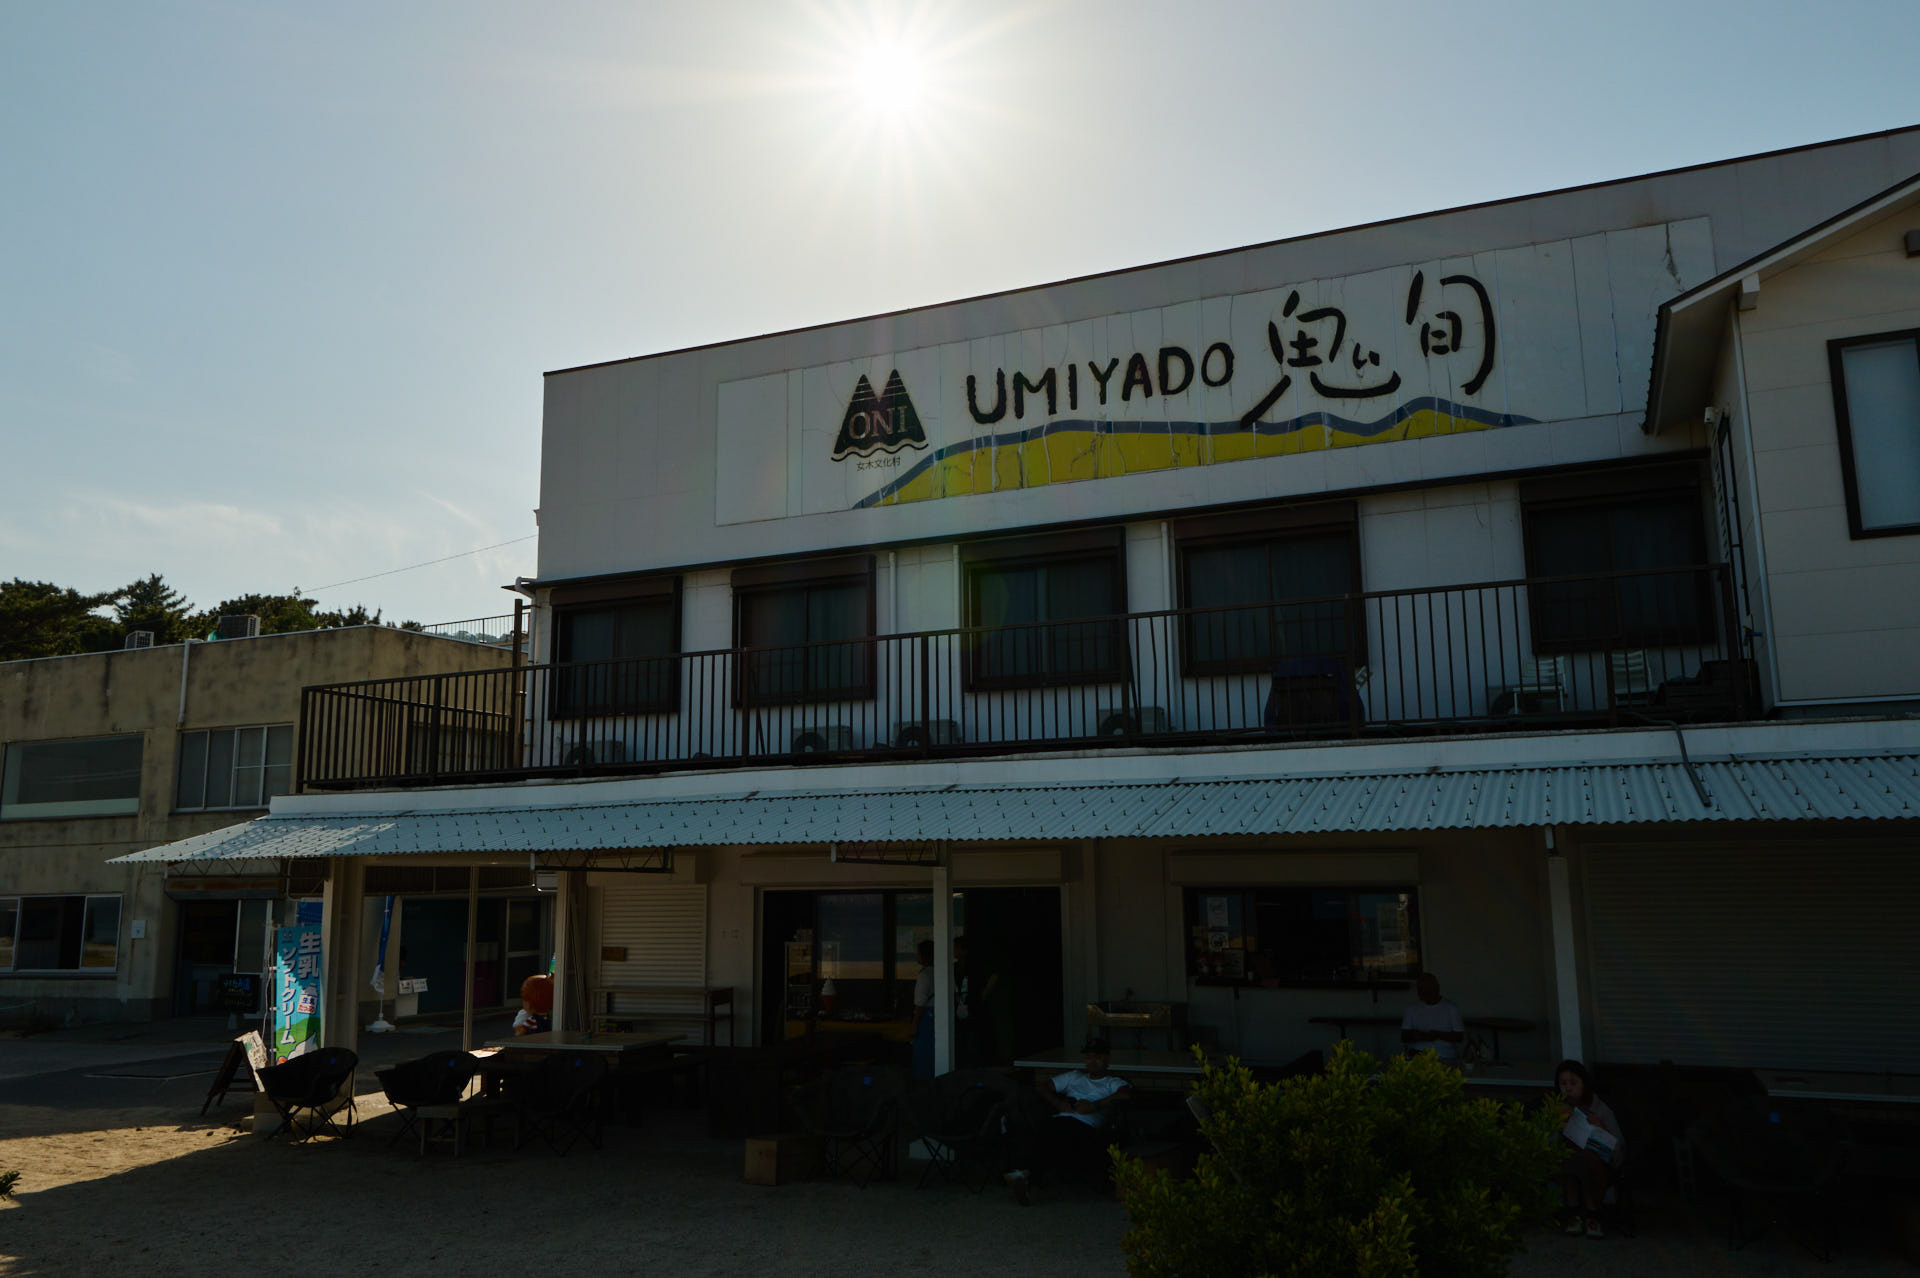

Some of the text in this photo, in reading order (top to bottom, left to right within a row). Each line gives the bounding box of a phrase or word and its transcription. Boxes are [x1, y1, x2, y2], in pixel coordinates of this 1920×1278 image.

[967, 342, 1235, 424] UMIYADO
[848, 405, 908, 440] ONI
[298, 931, 321, 979] 生乳
[280, 947, 298, 1044] ソフトクリーム
